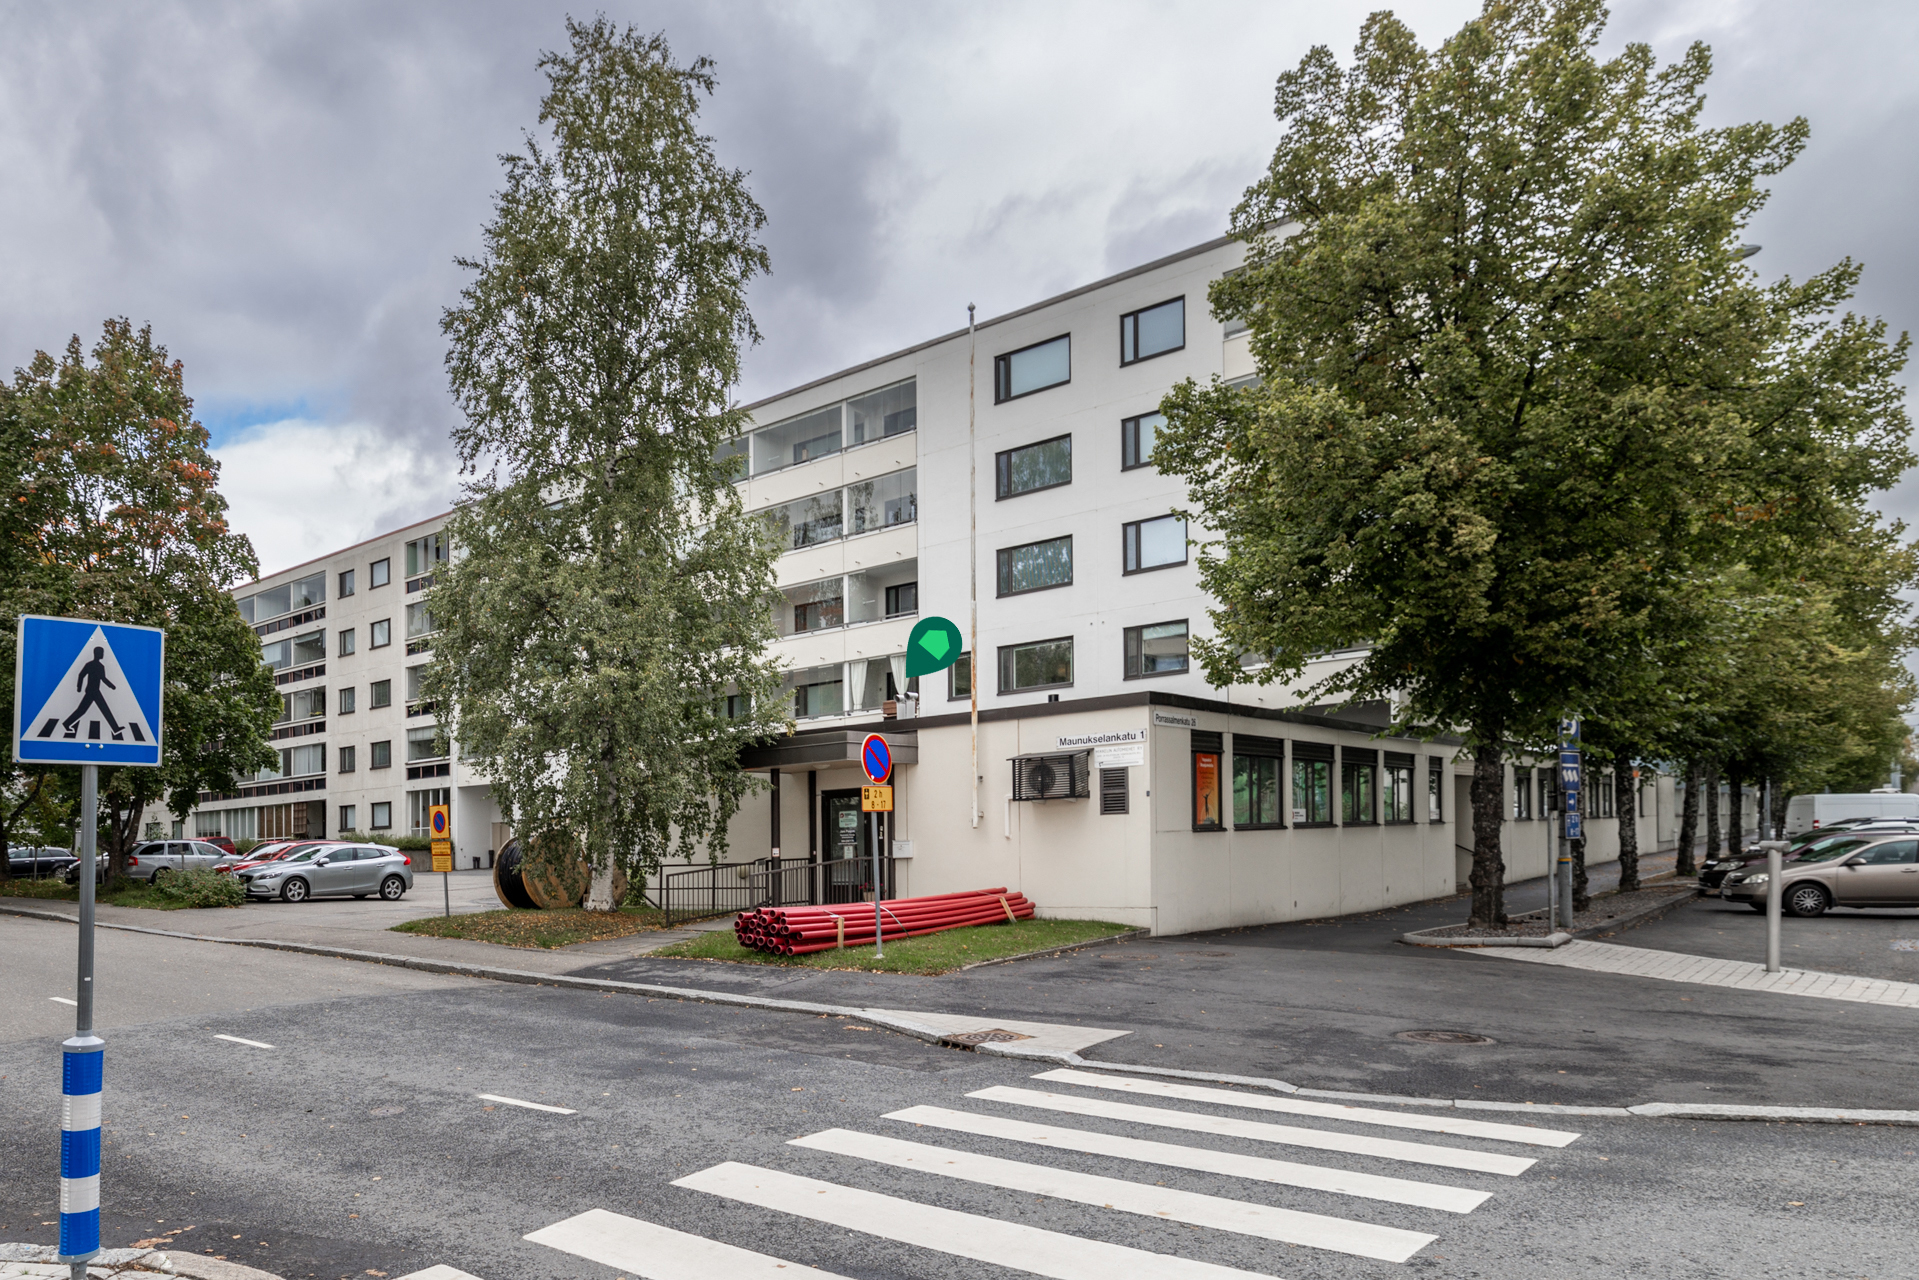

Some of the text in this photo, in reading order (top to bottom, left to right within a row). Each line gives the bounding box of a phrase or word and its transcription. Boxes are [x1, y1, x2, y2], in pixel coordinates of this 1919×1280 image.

[1060, 730, 1145, 746] Maunukselankatu 1
[874, 789, 878, 799] 2
